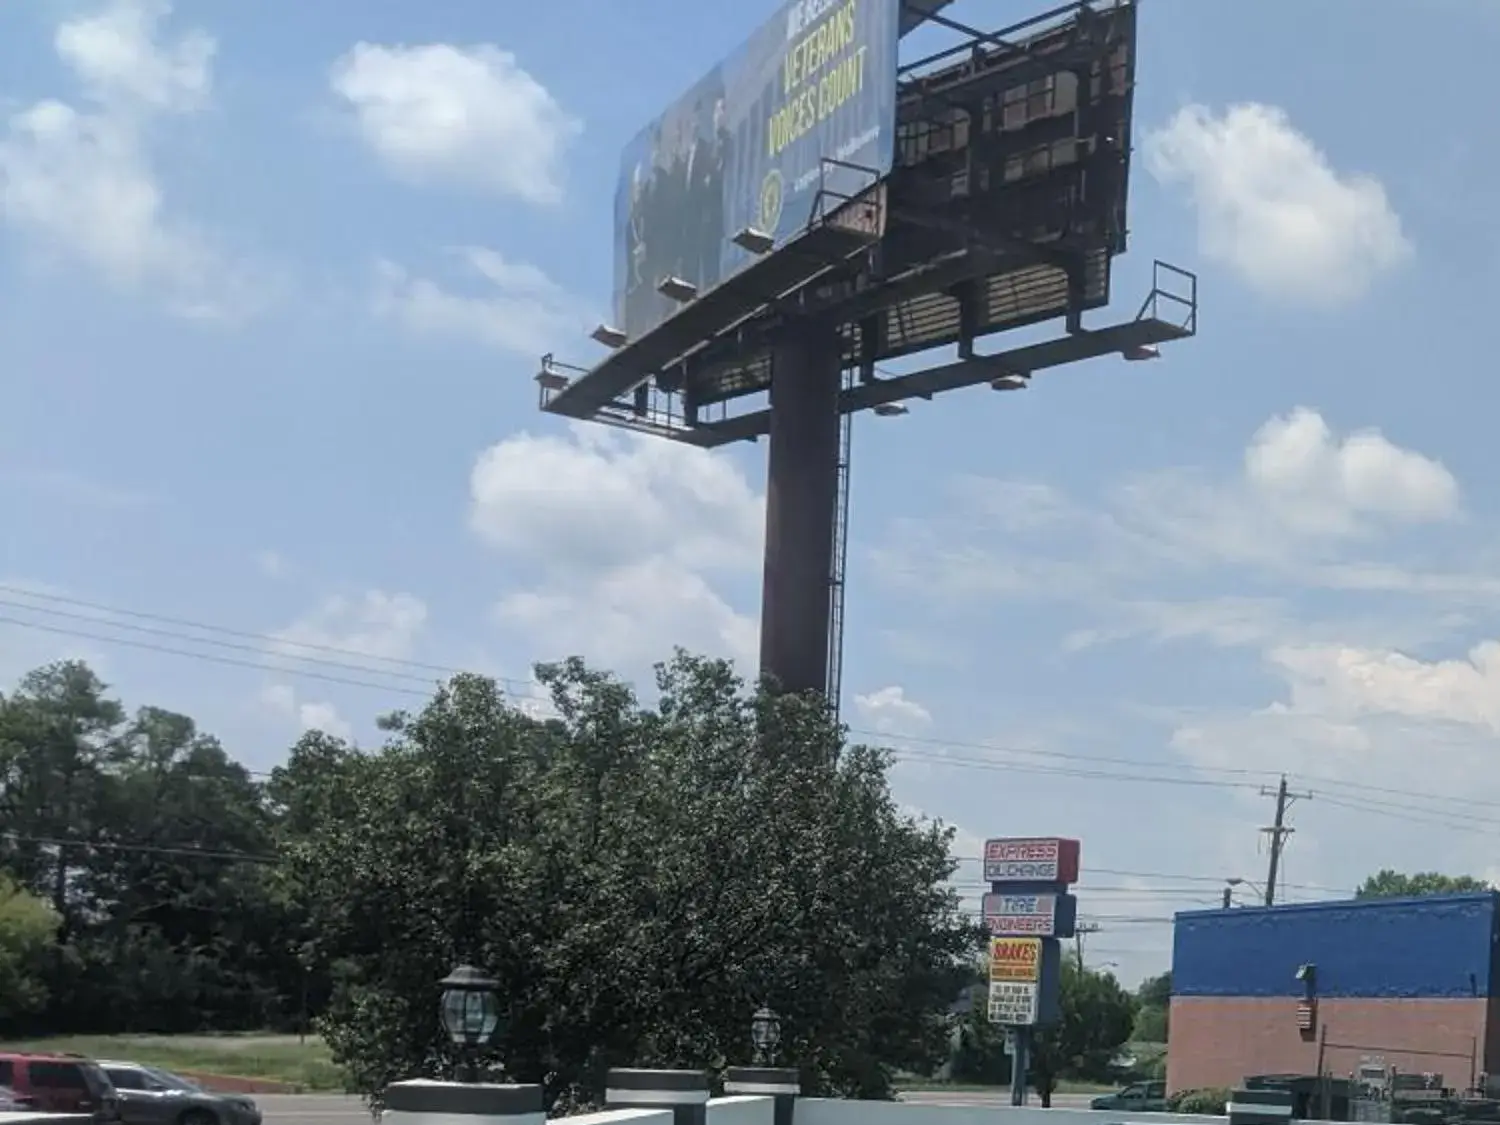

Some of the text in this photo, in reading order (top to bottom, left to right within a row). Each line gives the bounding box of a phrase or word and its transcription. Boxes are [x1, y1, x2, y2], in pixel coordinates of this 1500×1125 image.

[783, 0, 855, 95] VETERANS
[819, 45, 867, 121] COUNT
[987, 843, 1057, 860] EXPRESS
[1007, 862, 1055, 877] CHANGE
[1003, 897, 1037, 913] TIRE
[994, 941, 1037, 961] BRAKES
